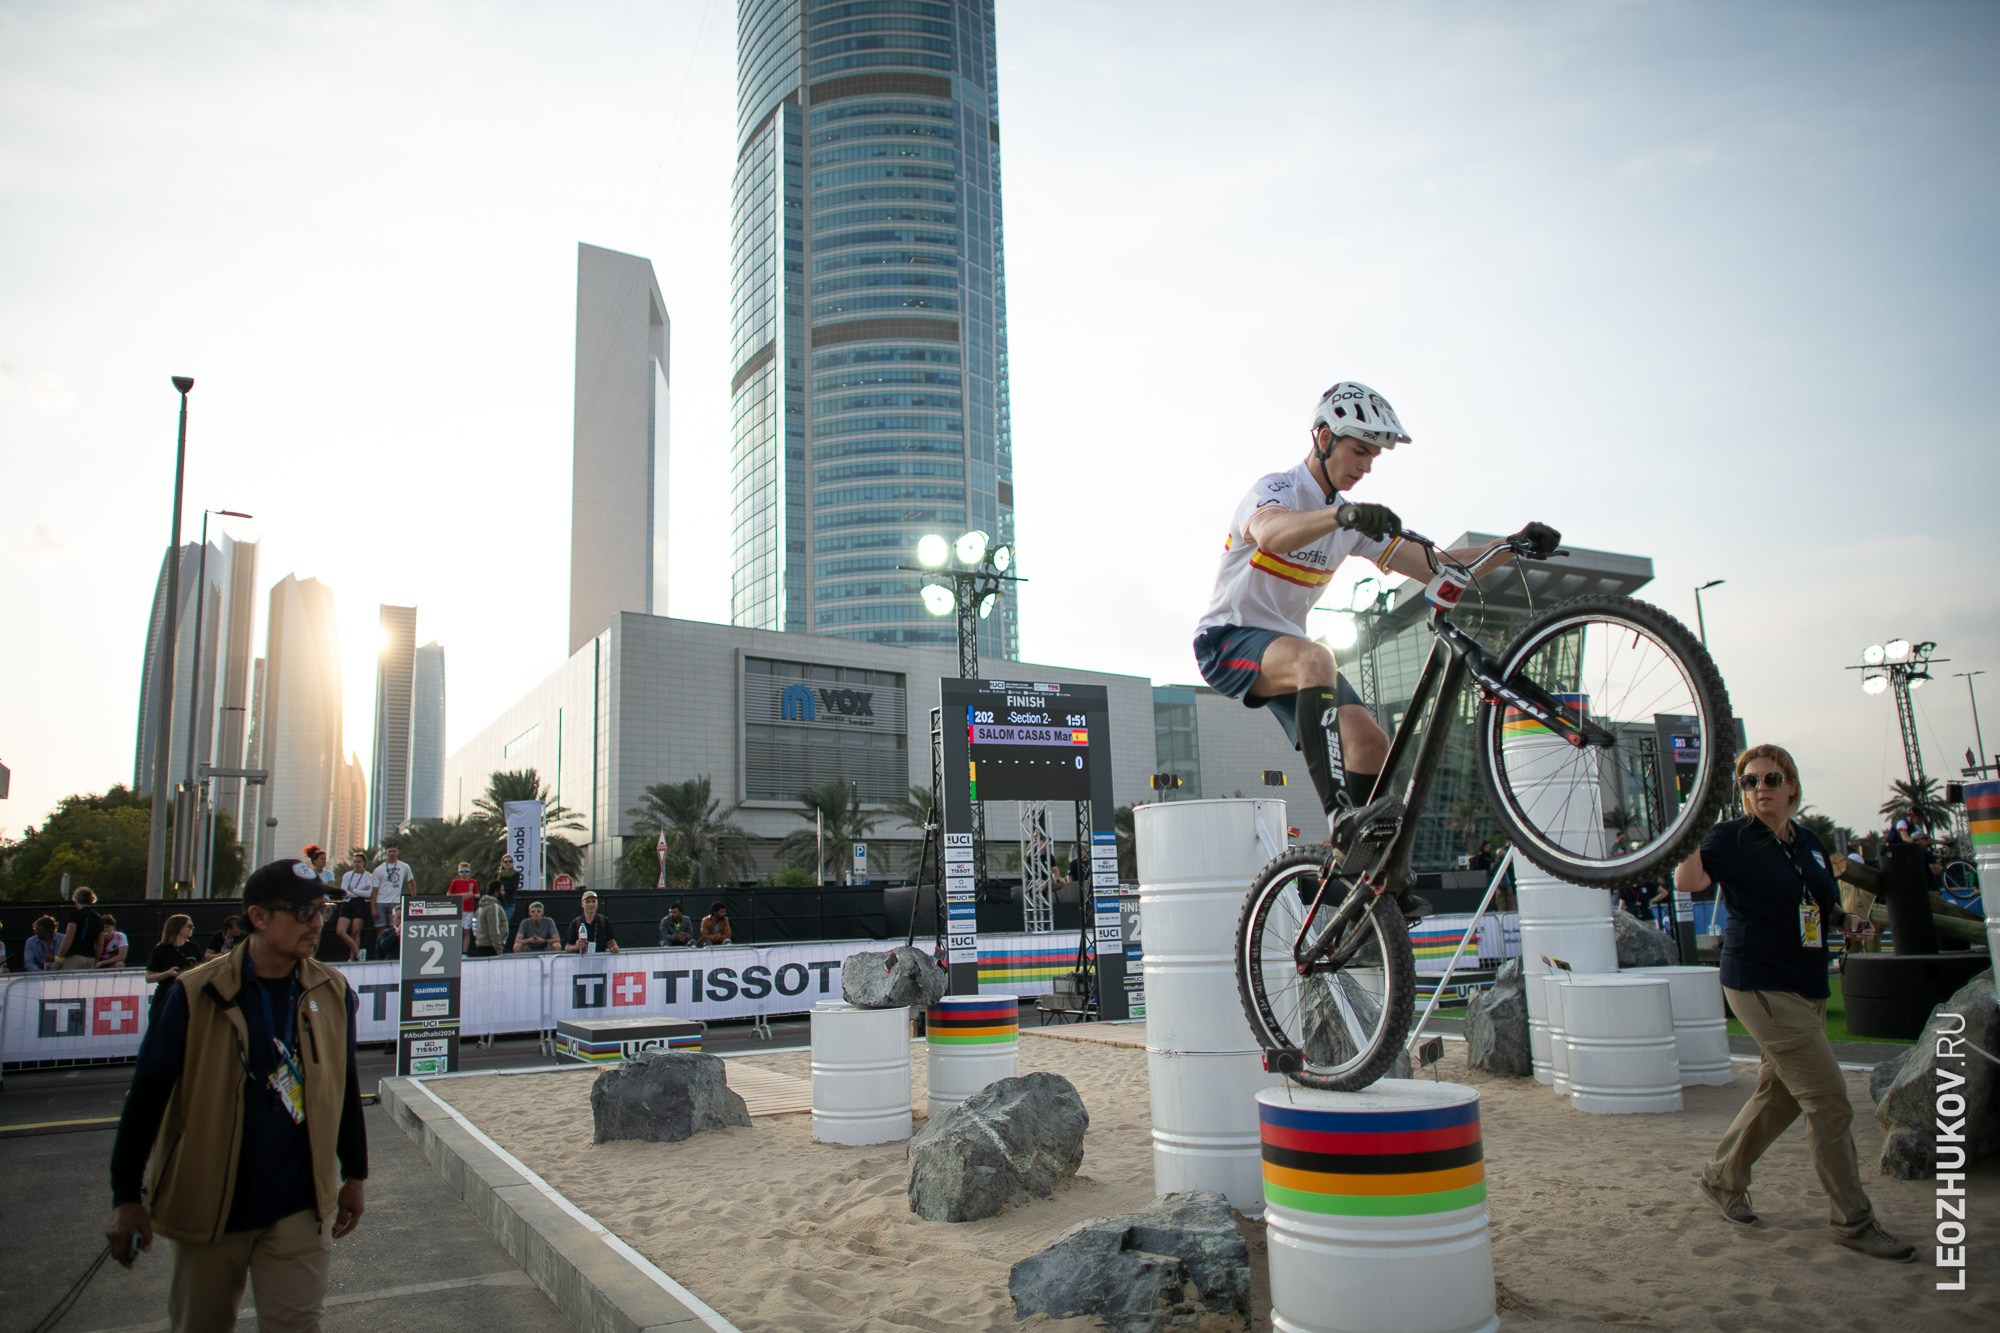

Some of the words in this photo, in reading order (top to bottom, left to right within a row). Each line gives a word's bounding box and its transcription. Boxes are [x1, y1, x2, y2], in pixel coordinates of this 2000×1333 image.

[819, 688, 874, 716] VOX
[1007, 696, 1045, 708] FINISH
[974, 711, 994, 723] 202
[1066, 714, 1086, 726] 1:51
[979, 728, 1015, 740] SALOM
[1018, 729, 1051, 741] CASAS
[513, 826, 525, 862] dhabi
[952, 835, 970, 844] UCI
[408, 924, 458, 938] START
[1103, 929, 1119, 938] UCI
[1128, 914, 1141, 941] 2
[955, 937, 974, 946] UCI
[420, 940, 445, 975] 2
[653, 961, 842, 1004] TISSOT
[414, 987, 447, 995] SHIMANO
[403, 1030, 456, 1039] #Abudhabi2024
